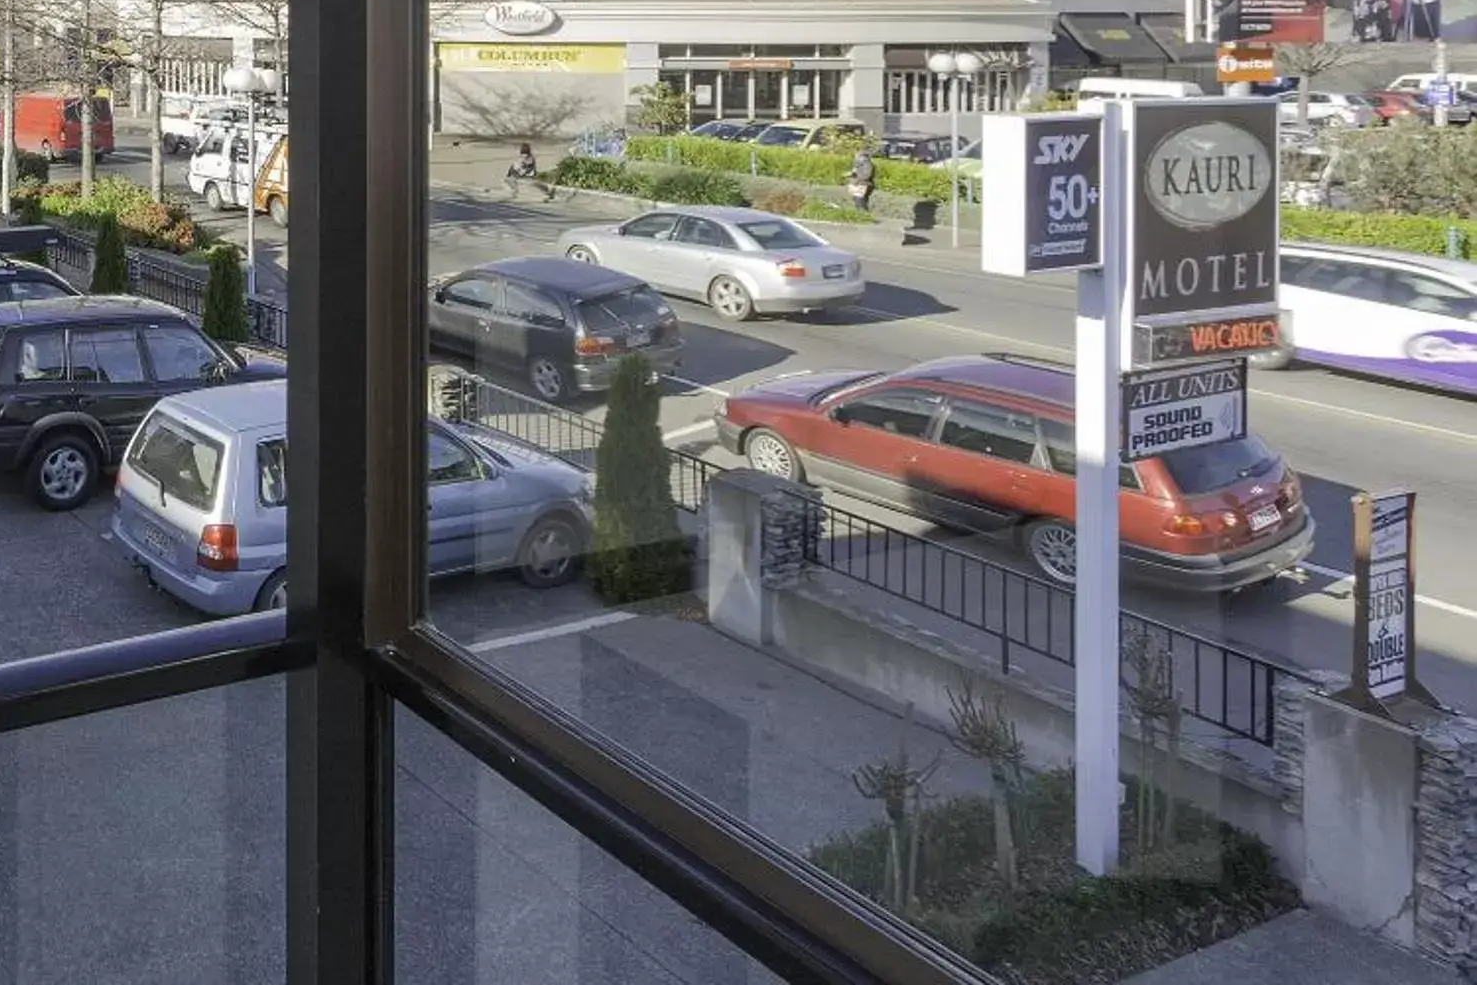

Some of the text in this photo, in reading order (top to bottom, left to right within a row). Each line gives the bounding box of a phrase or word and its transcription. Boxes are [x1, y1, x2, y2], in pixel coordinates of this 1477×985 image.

[1033, 134, 1089, 164] SKY
[1162, 154, 1256, 196] KAURI
[1048, 174, 1098, 220] 50+
[1140, 250, 1270, 300] MOTEL
[1190, 320, 1281, 352] VACANCY
[1132, 368, 1239, 407] ALL UNITS
[1144, 406, 1202, 430] SOUND
[1132, 422, 1214, 450] PROOFED
